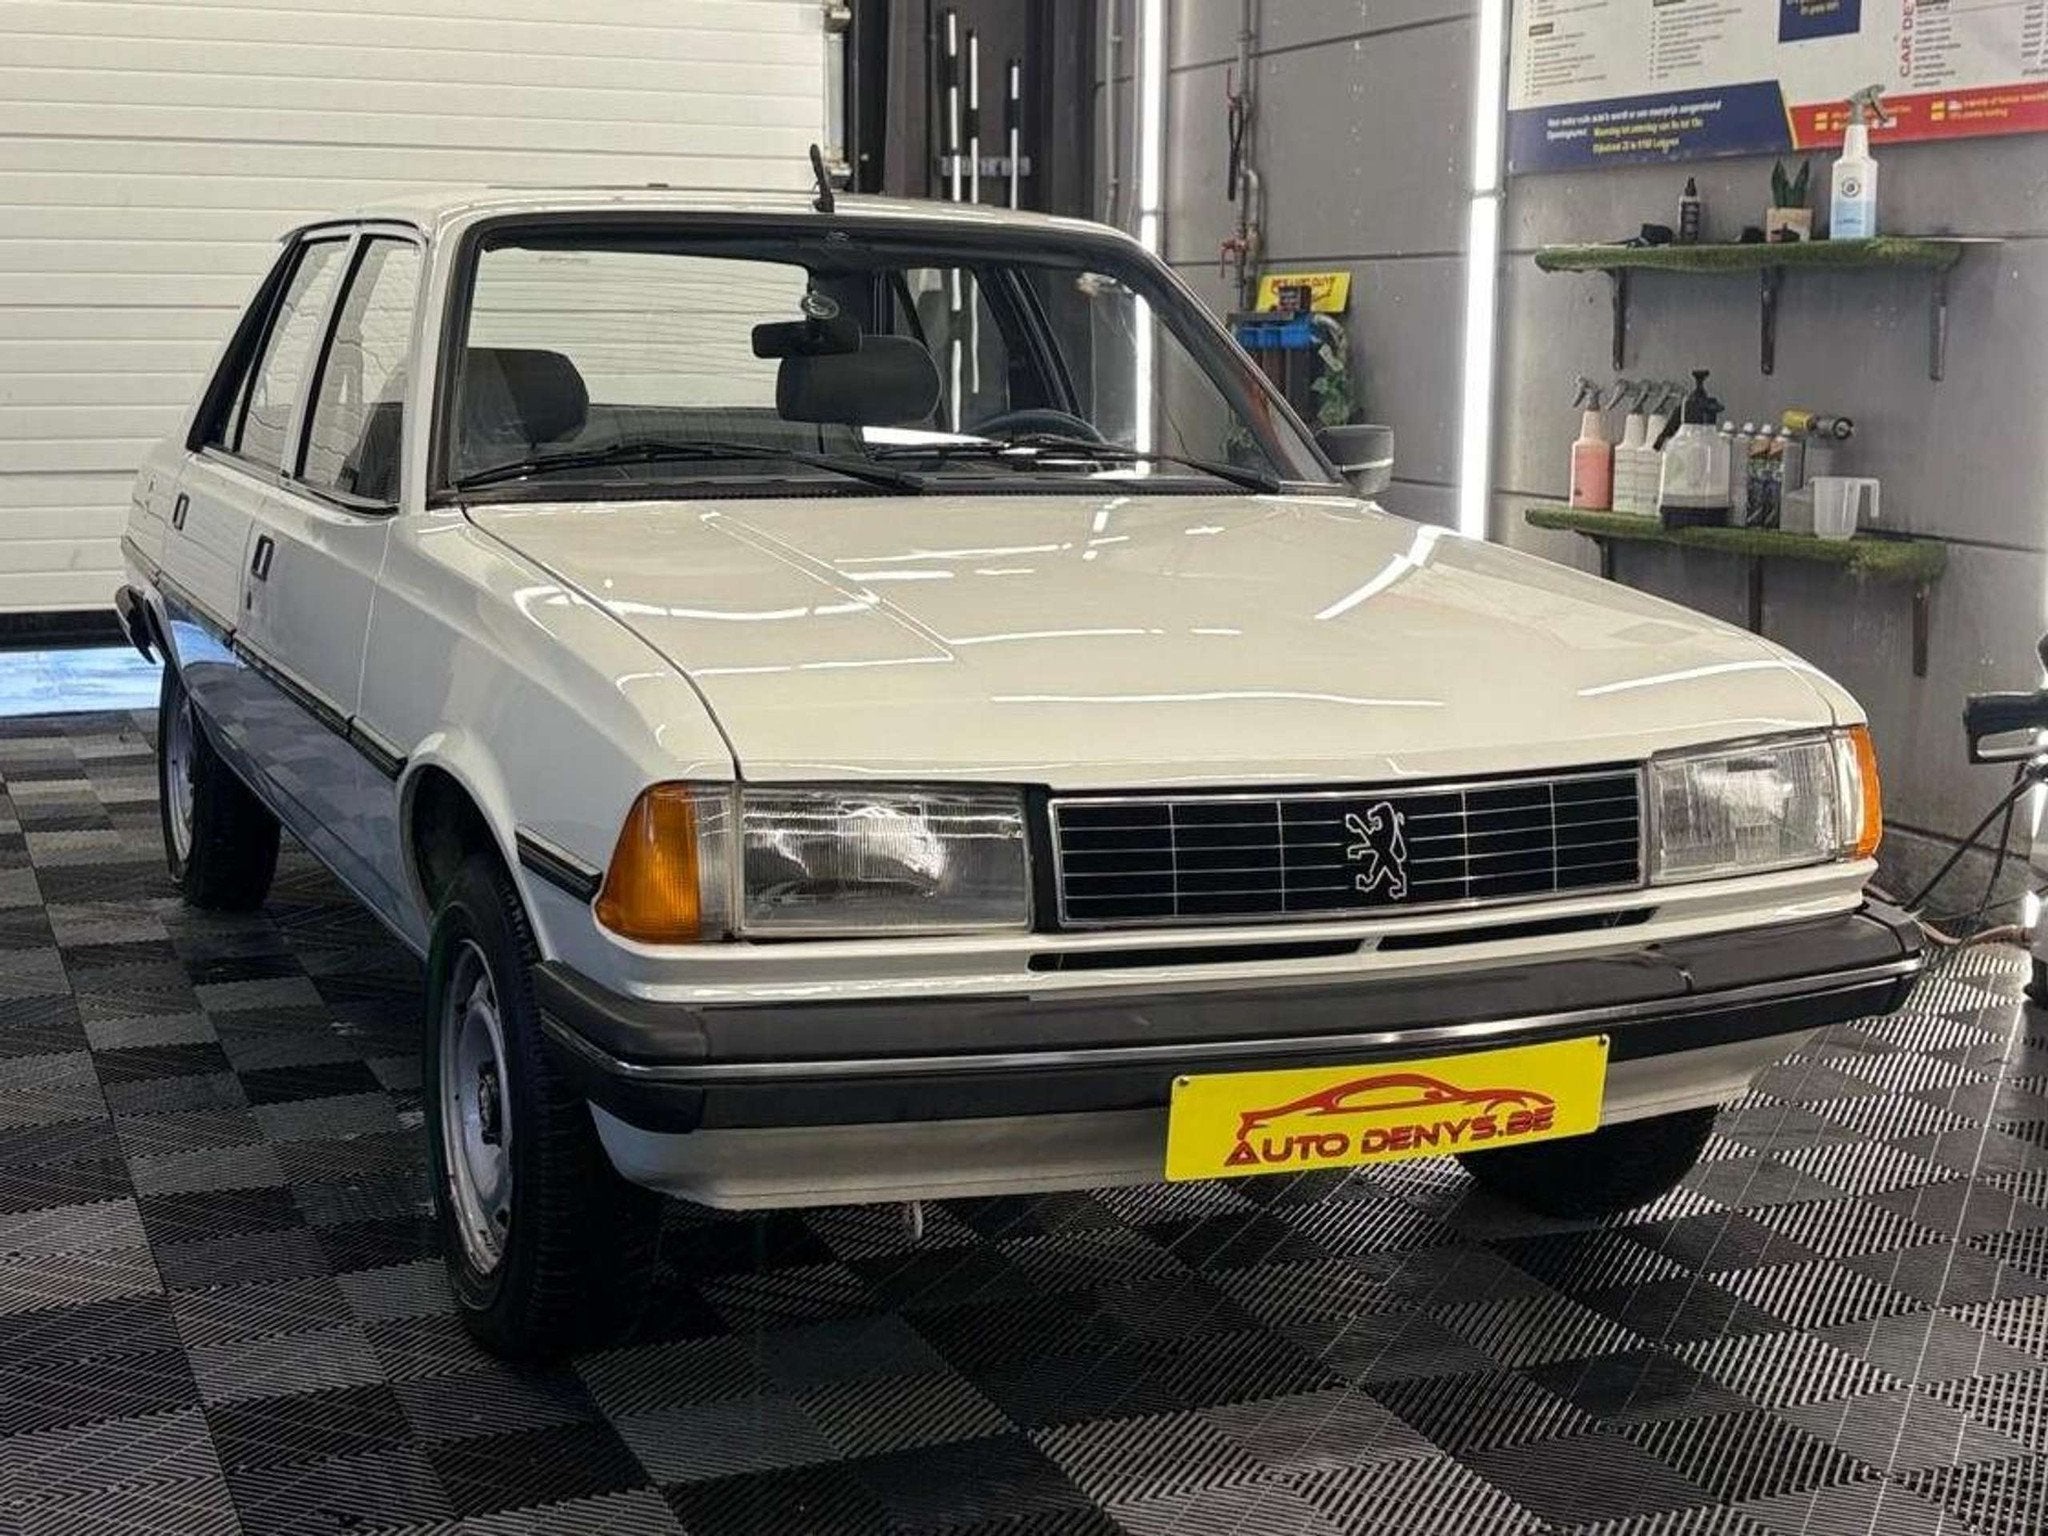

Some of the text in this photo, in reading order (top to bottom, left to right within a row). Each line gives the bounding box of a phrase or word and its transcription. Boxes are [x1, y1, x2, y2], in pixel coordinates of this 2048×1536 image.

[1900, 36, 1912, 77] CAR
[1223, 1107, 1556, 1167] AUTO DENYS.BE
